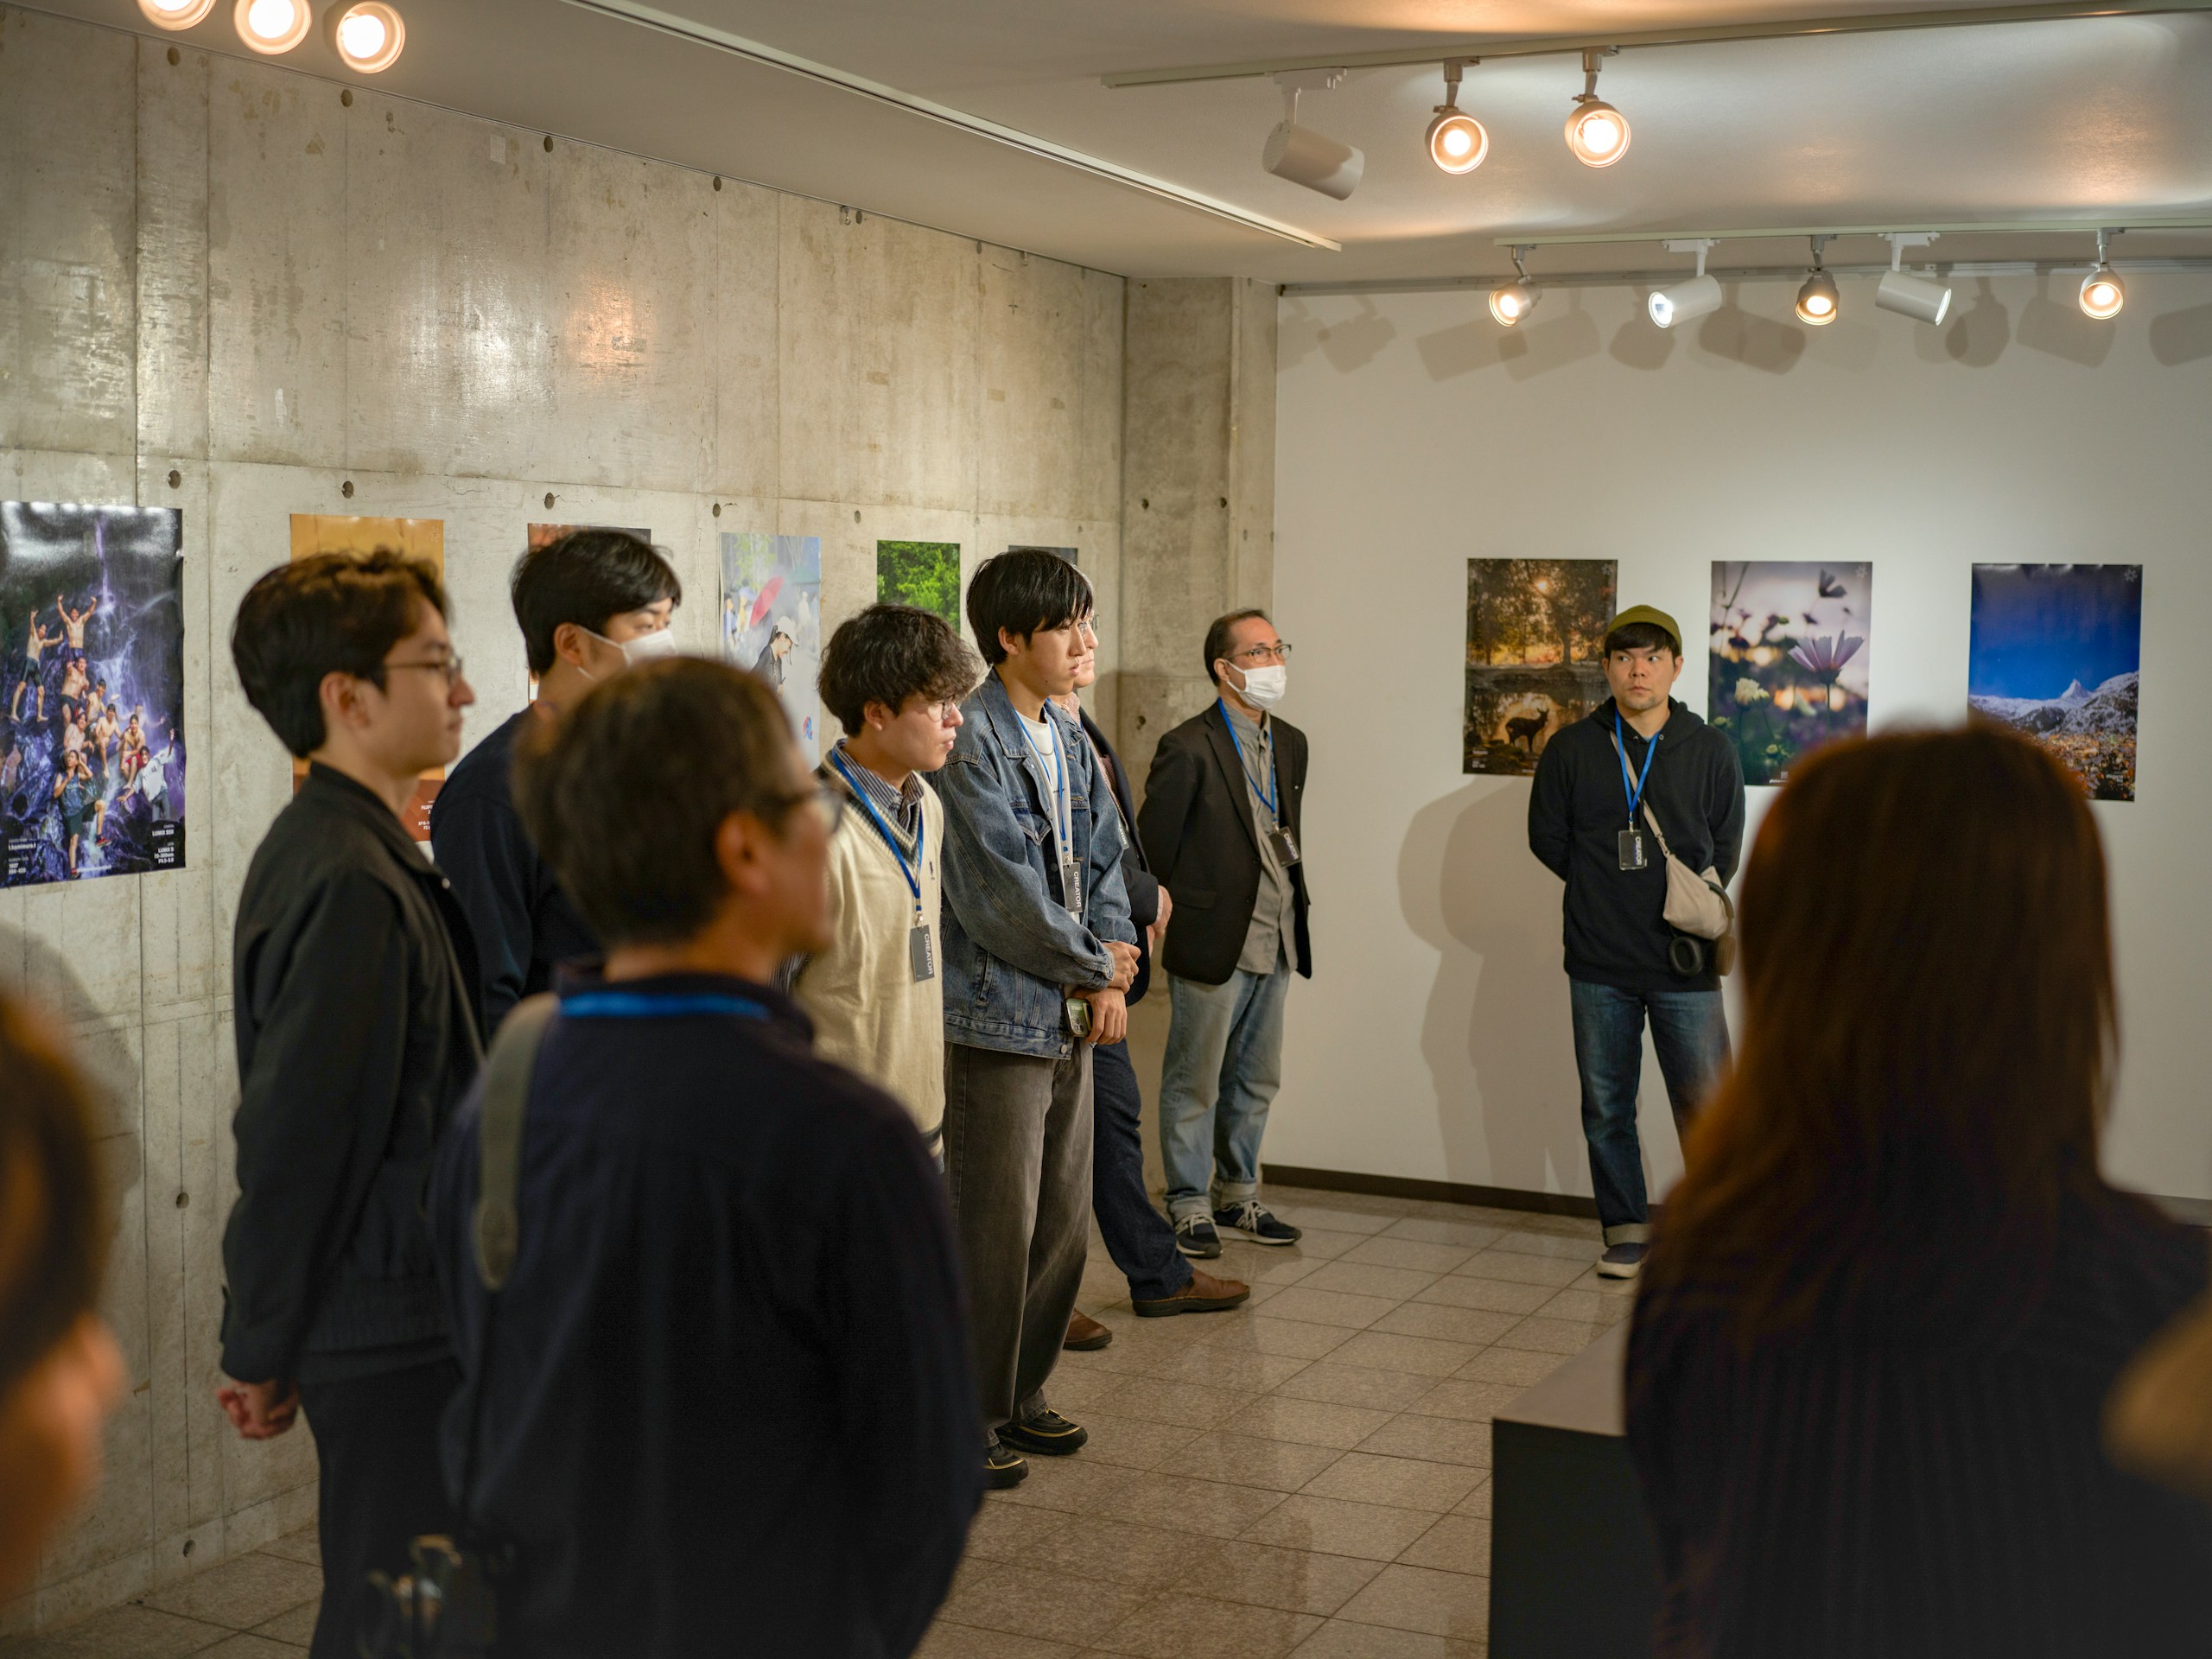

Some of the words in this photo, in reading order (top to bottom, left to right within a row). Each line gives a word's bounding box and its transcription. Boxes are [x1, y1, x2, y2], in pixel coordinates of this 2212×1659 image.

[1283, 833, 1299, 860] CREATOR
[1073, 871, 1082, 908] CREATOR
[925, 934, 933, 976] CREATOR
